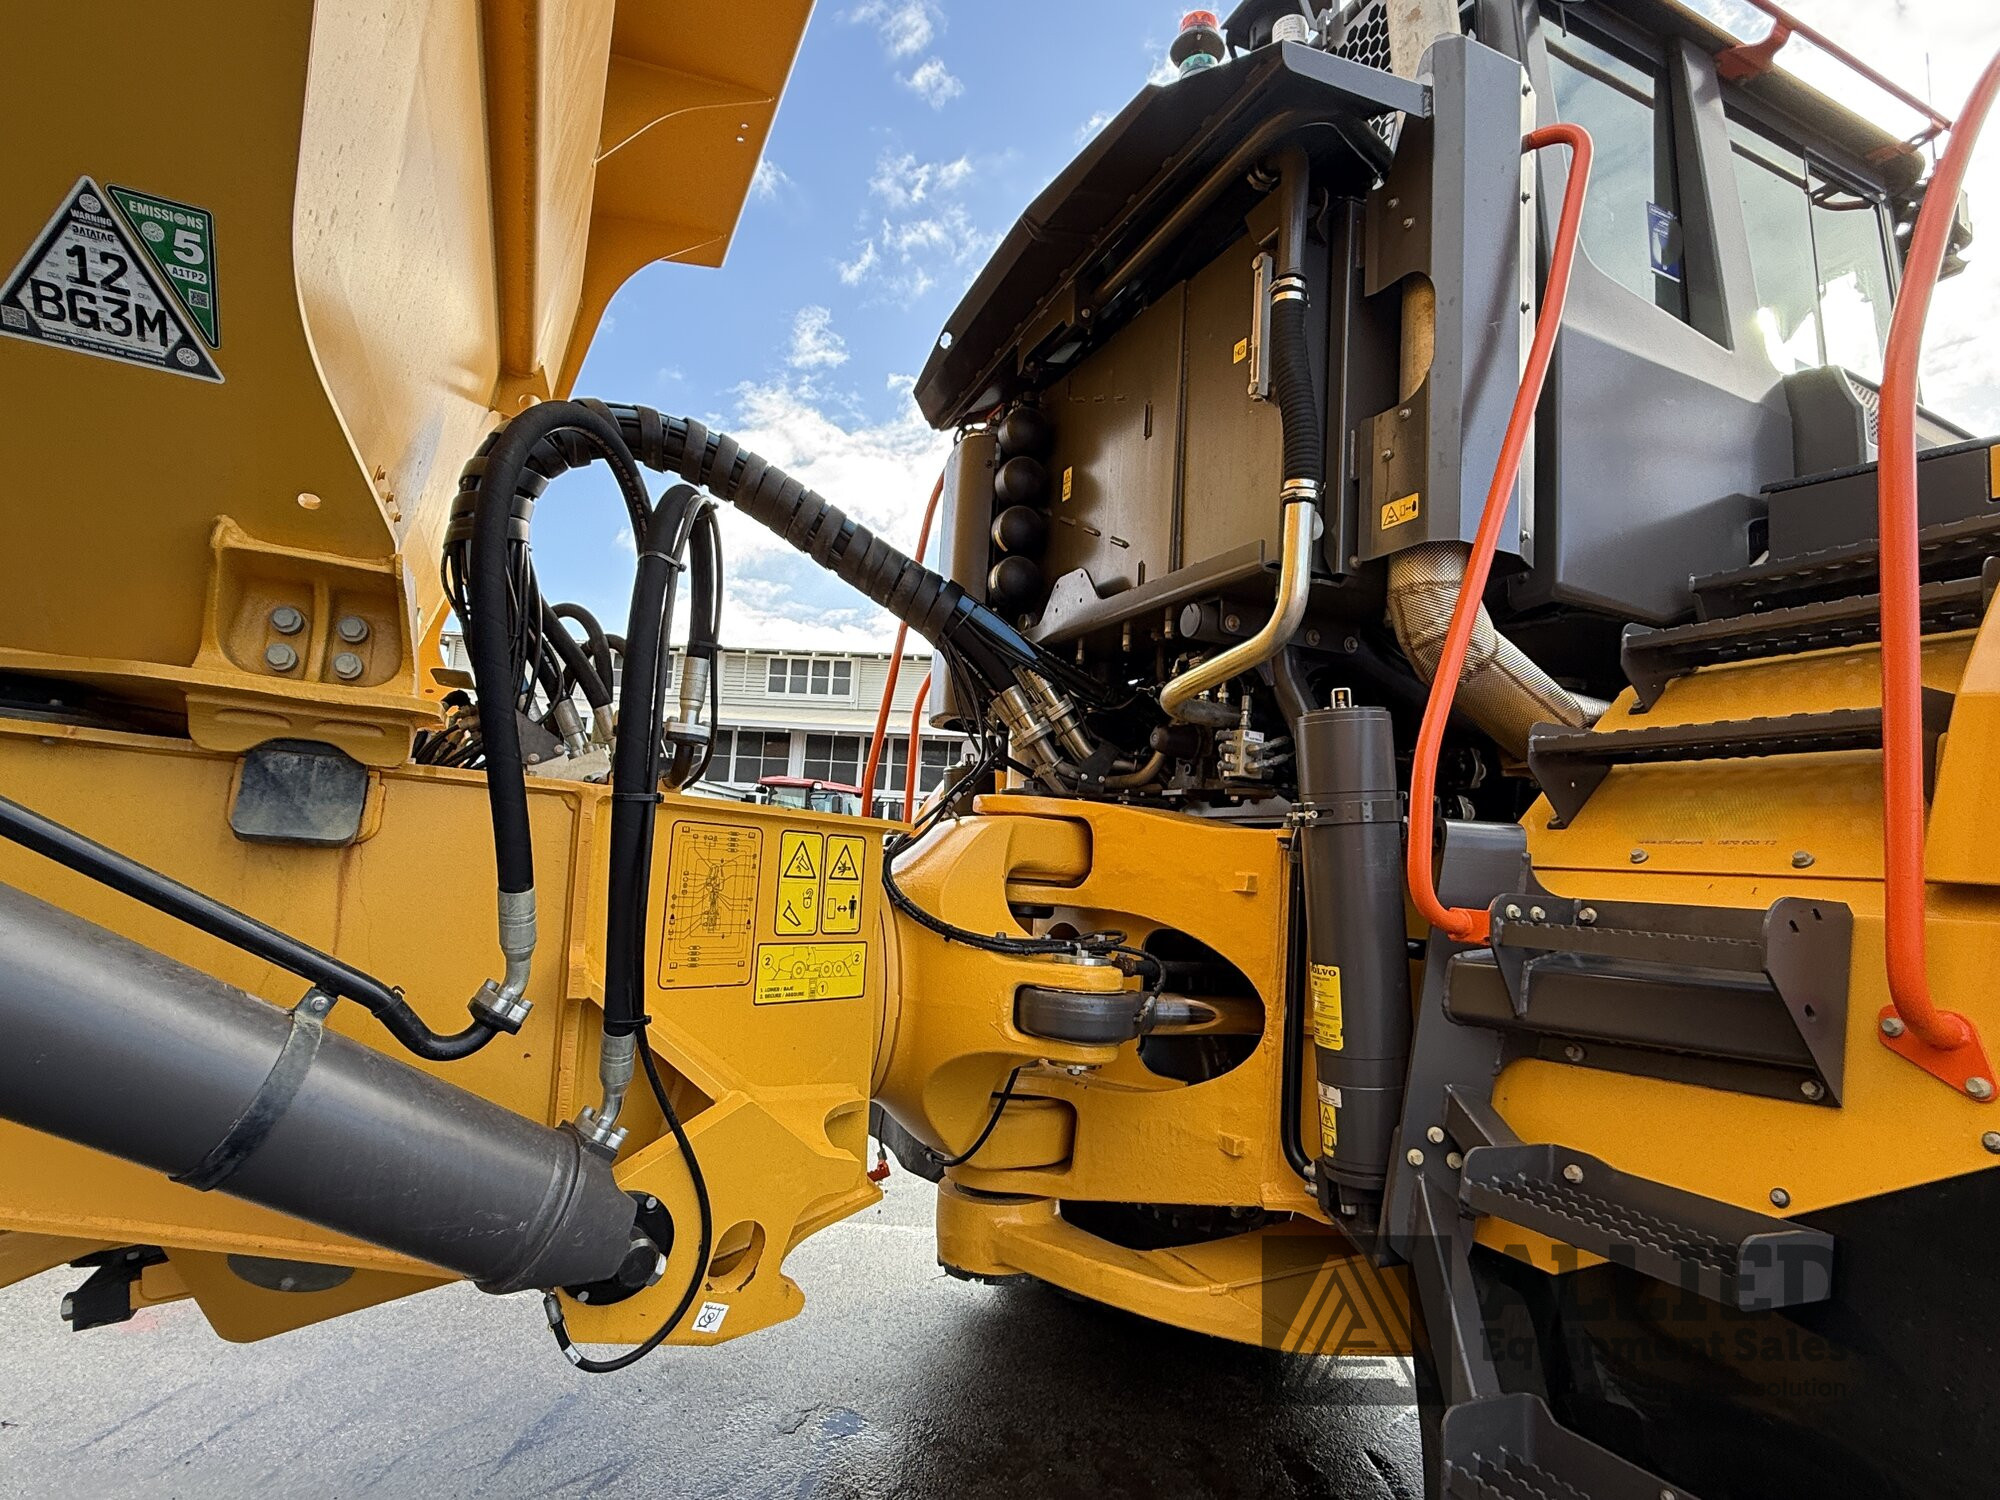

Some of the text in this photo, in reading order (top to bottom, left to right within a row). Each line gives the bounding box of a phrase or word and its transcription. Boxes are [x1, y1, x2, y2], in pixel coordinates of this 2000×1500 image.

[70, 209, 113, 227] WARNING
[129, 200, 204, 230] EMISSIONS
[71, 224, 115, 243] DATATAG
[173, 229, 204, 264] 5
[66, 245, 130, 296] 12
[172, 266, 205, 282] A1TP2
[30, 277, 168, 347] BG3M
[765, 957, 771, 966] 2
